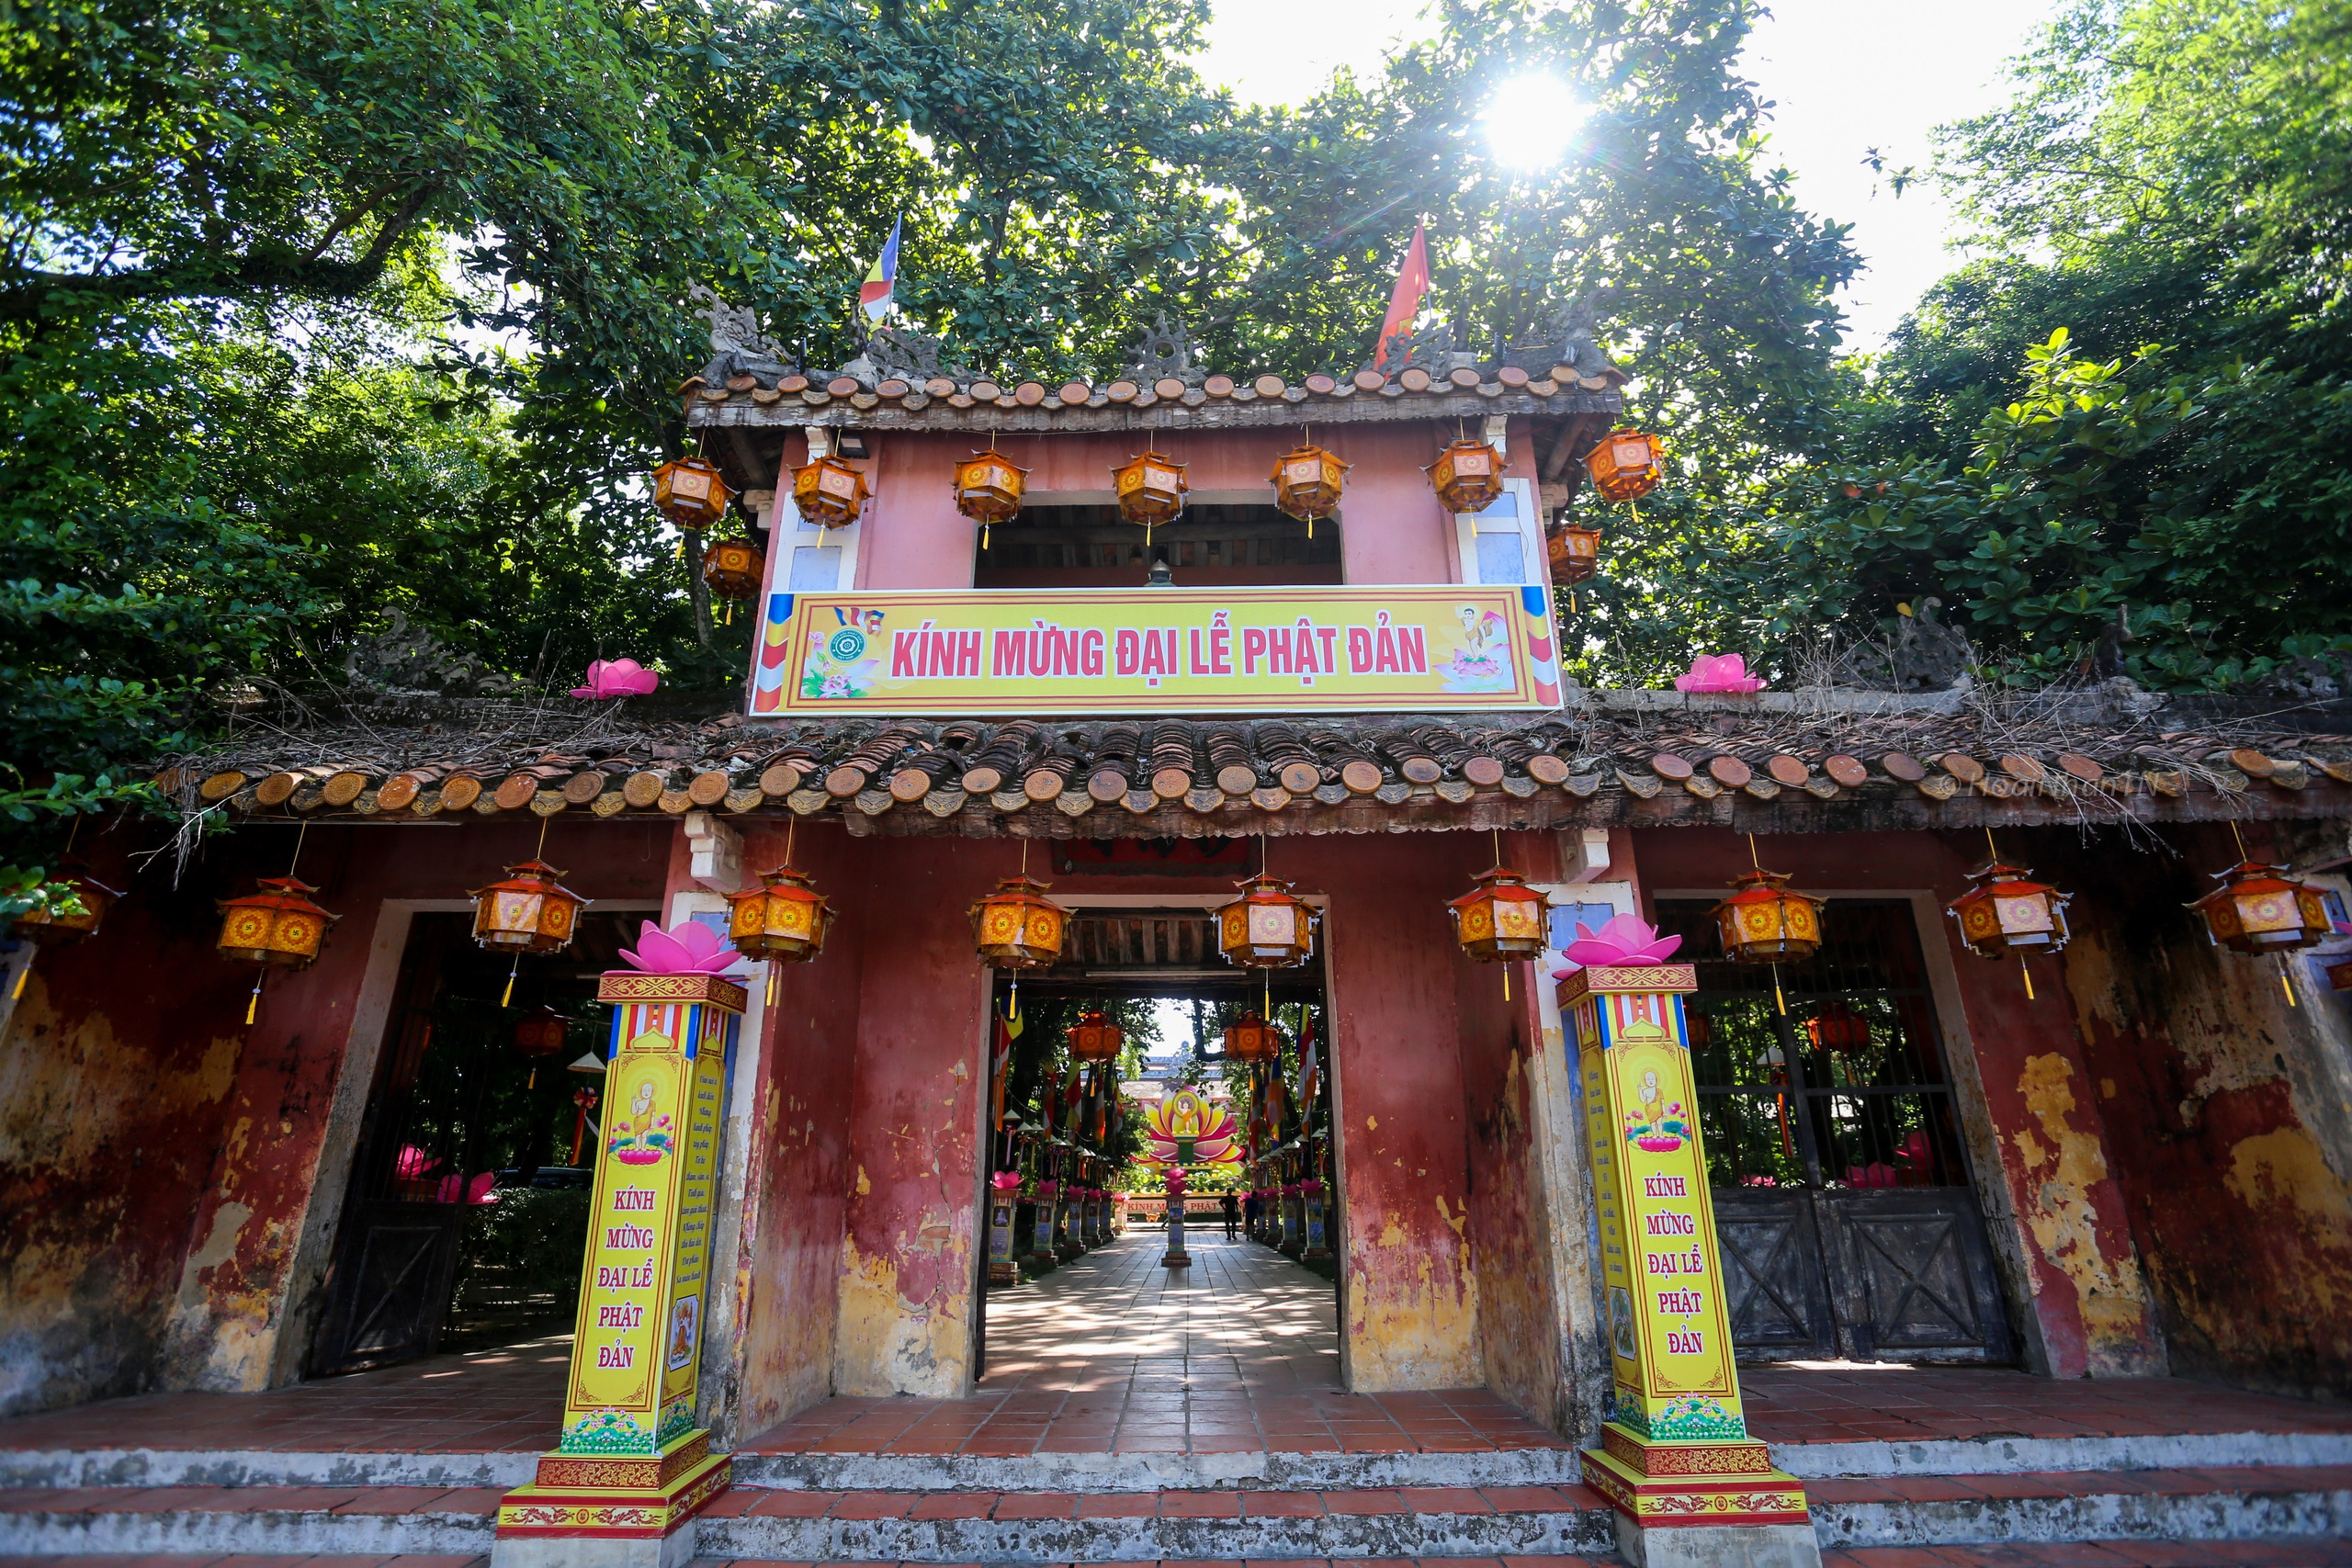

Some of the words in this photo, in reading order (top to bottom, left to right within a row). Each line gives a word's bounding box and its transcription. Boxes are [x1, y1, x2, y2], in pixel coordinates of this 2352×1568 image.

[892, 622, 980, 677] KÍNH
[992, 621, 1103, 676] MỪNG
[1116, 629, 1177, 685] ĐẠI
[1191, 612, 1231, 674] LỄ
[1243, 618, 1337, 684] PHẬT
[1349, 612, 1427, 673] ĐẢN
[614, 1185, 656, 1210] KÍNH
[1645, 1172, 1687, 1197] KÍNH
[605, 1223, 653, 1248] MỪNG
[1645, 1209, 1694, 1235] MỪNG
[597, 1267, 628, 1293] ĐẠI
[631, 1258, 653, 1288] LỄ
[1647, 1253, 1678, 1280] ĐẠI
[1681, 1244, 1703, 1273] LỄ
[598, 1301, 643, 1333] PHẬT
[1657, 1287, 1702, 1319] PHẬT
[598, 1339, 634, 1368] ĐẢN
[1668, 1325, 1704, 1353] ĐẢN
